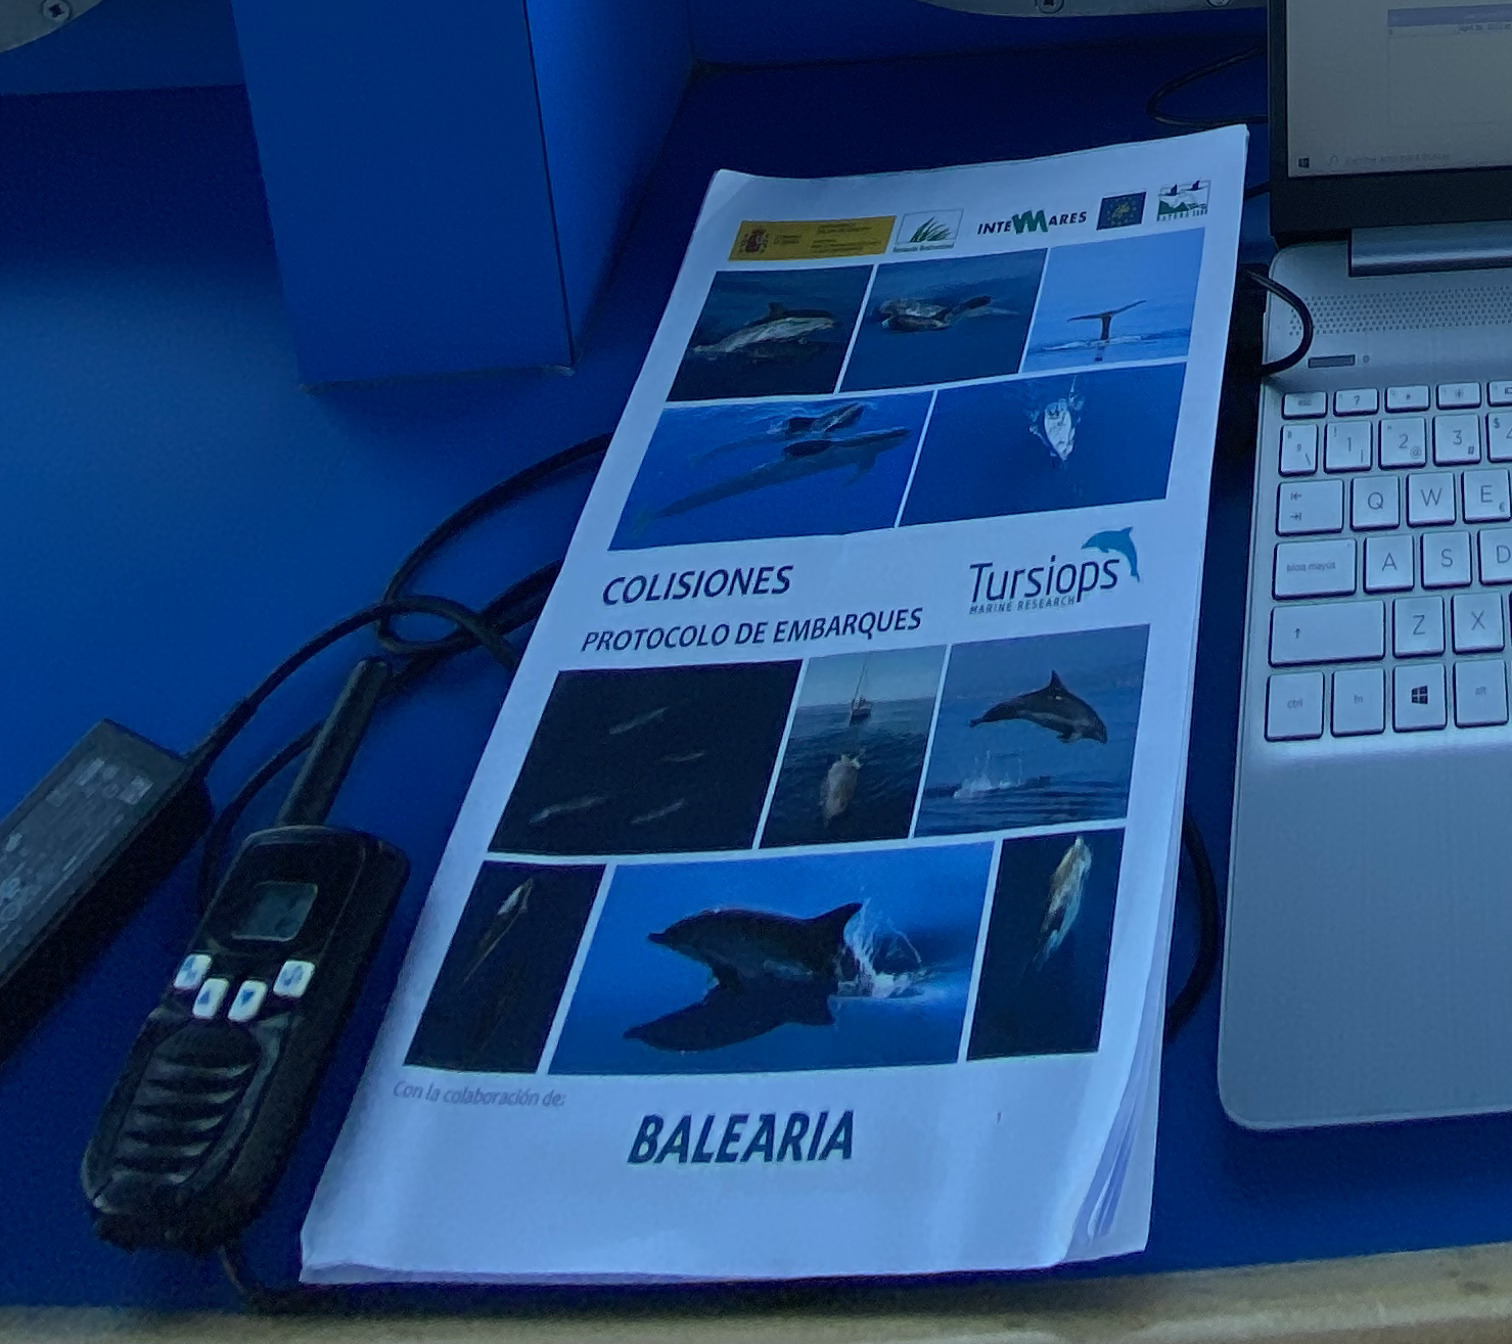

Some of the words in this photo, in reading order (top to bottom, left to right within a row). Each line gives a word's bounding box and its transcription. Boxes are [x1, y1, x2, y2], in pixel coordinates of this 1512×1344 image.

[1398, 433, 1410, 451] 2
[1452, 429, 1464, 447] 3
[1367, 491, 1384, 511] Q
[1420, 487, 1442, 507] W
[1480, 484, 1493, 503] E
[1381, 552, 1398, 572] A
[1440, 548, 1454, 569] S
[1496, 544, 1512, 564] D
[603, 565, 794, 606] COLISIONES
[969, 555, 1121, 604] Tursiops
[970, 600, 1013, 615] MARINE
[1017, 595, 1076, 612] RESEARCH
[582, 622, 730, 653] PROTOCOLO
[735, 620, 767, 646] DE
[773, 607, 924, 644] EMBARQUES
[1412, 614, 1426, 636] Z
[1471, 610, 1486, 631] X
[393, 1080, 422, 1101] Con
[425, 1082, 439, 1103] la
[443, 1083, 540, 1107] colaboración
[628, 1109, 856, 1165] BALEARIA
